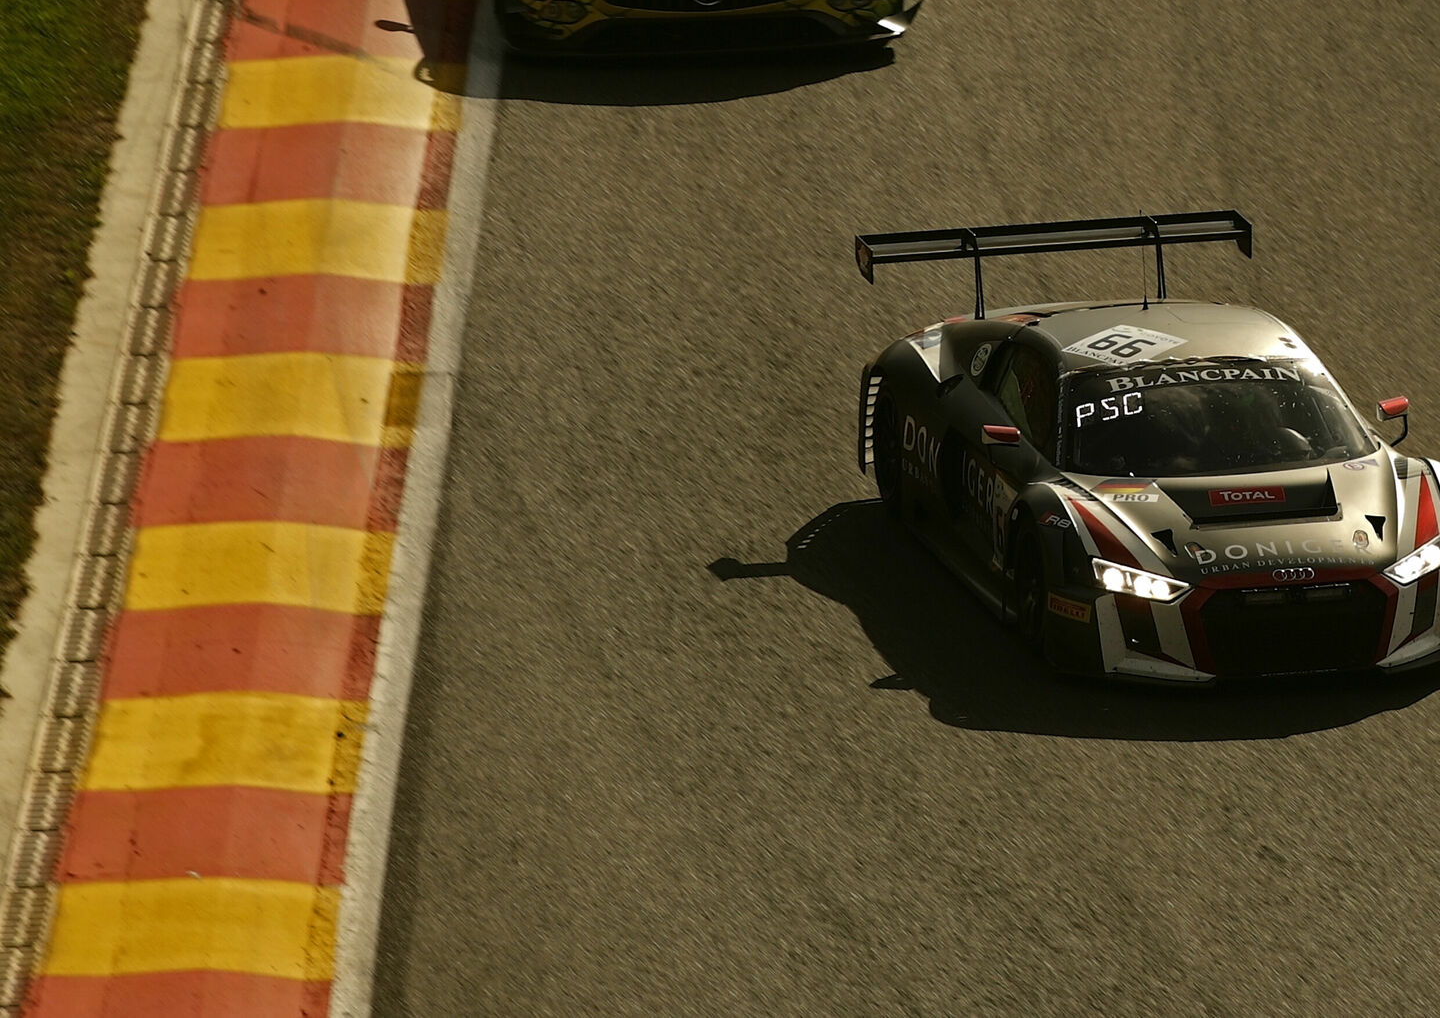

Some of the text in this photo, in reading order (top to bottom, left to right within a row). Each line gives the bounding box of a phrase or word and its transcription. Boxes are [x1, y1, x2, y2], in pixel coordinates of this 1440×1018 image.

[1087, 333, 1156, 358] 66
[1107, 366, 1302, 393] BLANCPAIN
[1075, 392, 1144, 428] PSC
[1112, 493, 1150, 503] PRO
[1219, 489, 1277, 502] TOTAL
[1200, 556, 1376, 575] URBAN DEVELOPMENTS
